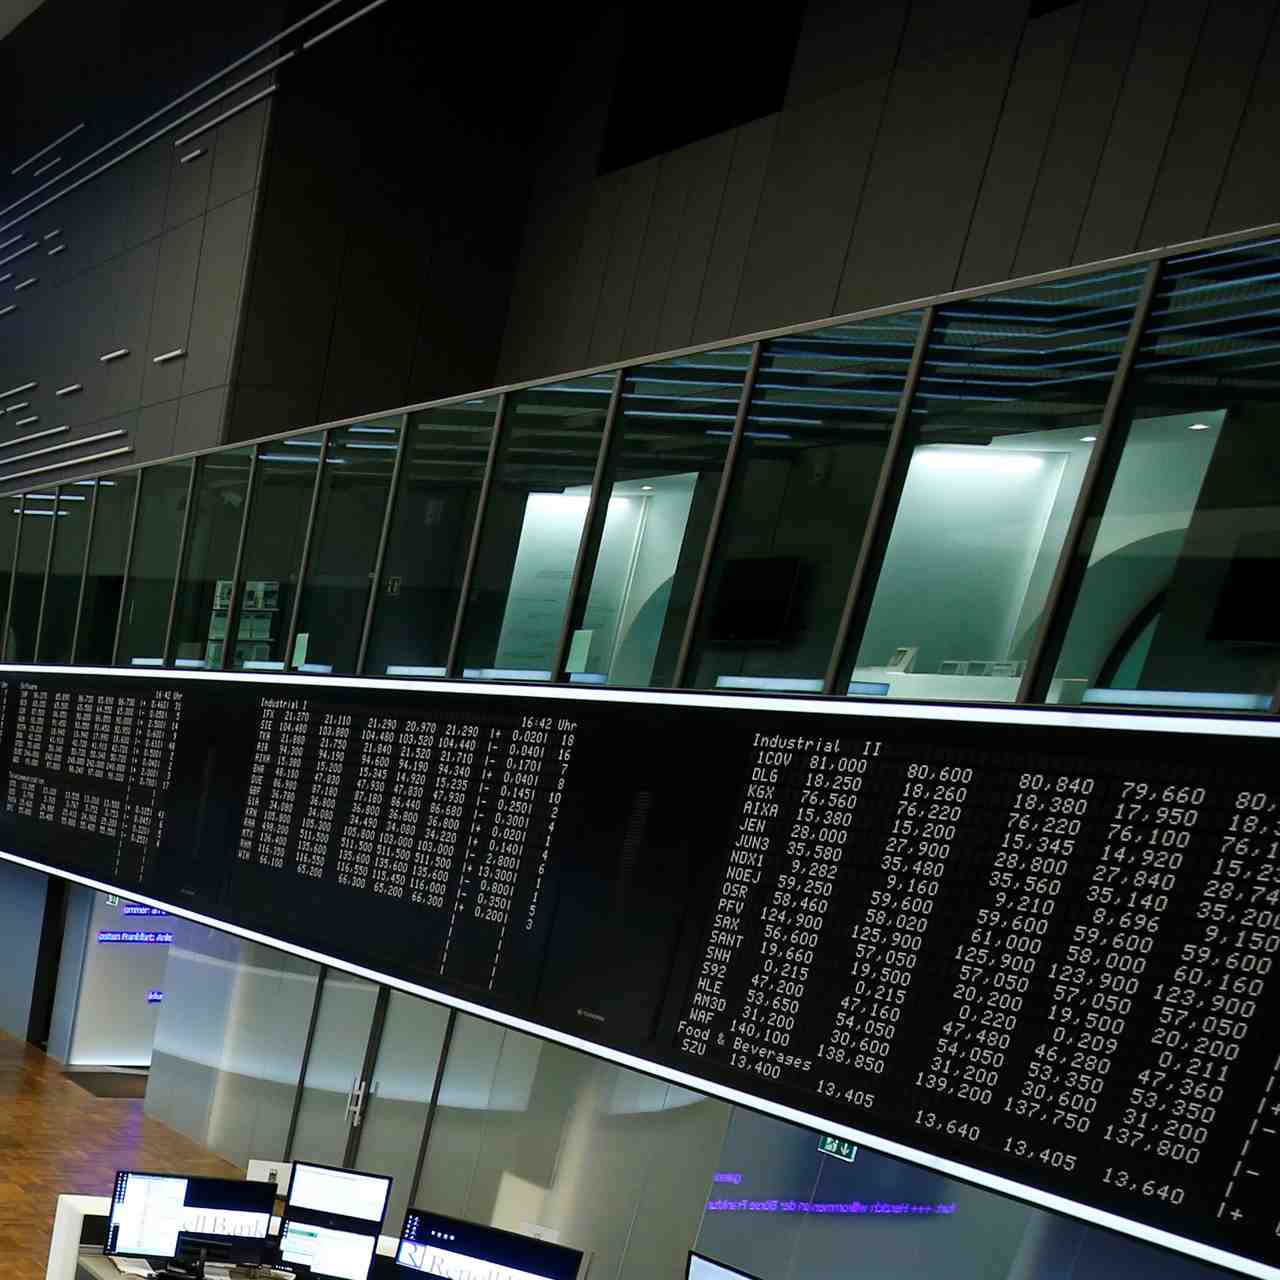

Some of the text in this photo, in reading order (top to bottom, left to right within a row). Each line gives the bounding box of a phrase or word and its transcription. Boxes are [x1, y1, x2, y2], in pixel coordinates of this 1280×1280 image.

[261, 698, 298, 709] Industrial
[446, 724, 479, 737] 21,290
[522, 716, 577, 731] 16:42 Uhr
[439, 737, 476, 751] 104,440
[440, 750, 473, 764] 21,710
[753, 733, 882, 756] Industrial II
[757, 751, 1205, 805] 1COV 81,000 80,600 79,660
[747, 784, 1190, 848] KGX 76,560 76,220 76,100
[752, 767, 1198, 826] DLG 18,250 18,260 17,950
[739, 817, 1176, 890] JEN 28,000 27,900 27,840
[743, 801, 1183, 869] AIXA 15,380 15,200 14,920
[735, 834, 1168, 911] JUN3 35,580 35,480 35,140
[792, 859, 838, 879] 9,282
[1093, 908, 1160, 932] 8,696
[718, 898, 1139, 994] PFV 124,900 123,900
[722, 882, 1146, 974] OSR 58,460 58,000
[778, 875, 832, 896] 59,250
[1073, 925, 1153, 953] 59,600
[705, 946, 1118, 1054] SNH 0,215 0,209
[709, 930, 1125, 1034] SANT 19,660 19,500
[713, 914, 1132, 1014] SAX 56,600 57,050
[677, 1021, 710, 1040] Food
[733, 1037, 812, 1071] Beverages
[693, 992, 1097, 1113] AM3D 31,200 30,600
[697, 977, 1104, 1094] HLE 53,650 53,350
[701, 961, 1111, 1074] S92 47,200 46,280
[681, 1038, 1077, 1171] SZU 13,400 13,405
[689, 1008, 1090, 1133] WAF 140,100 137,750
